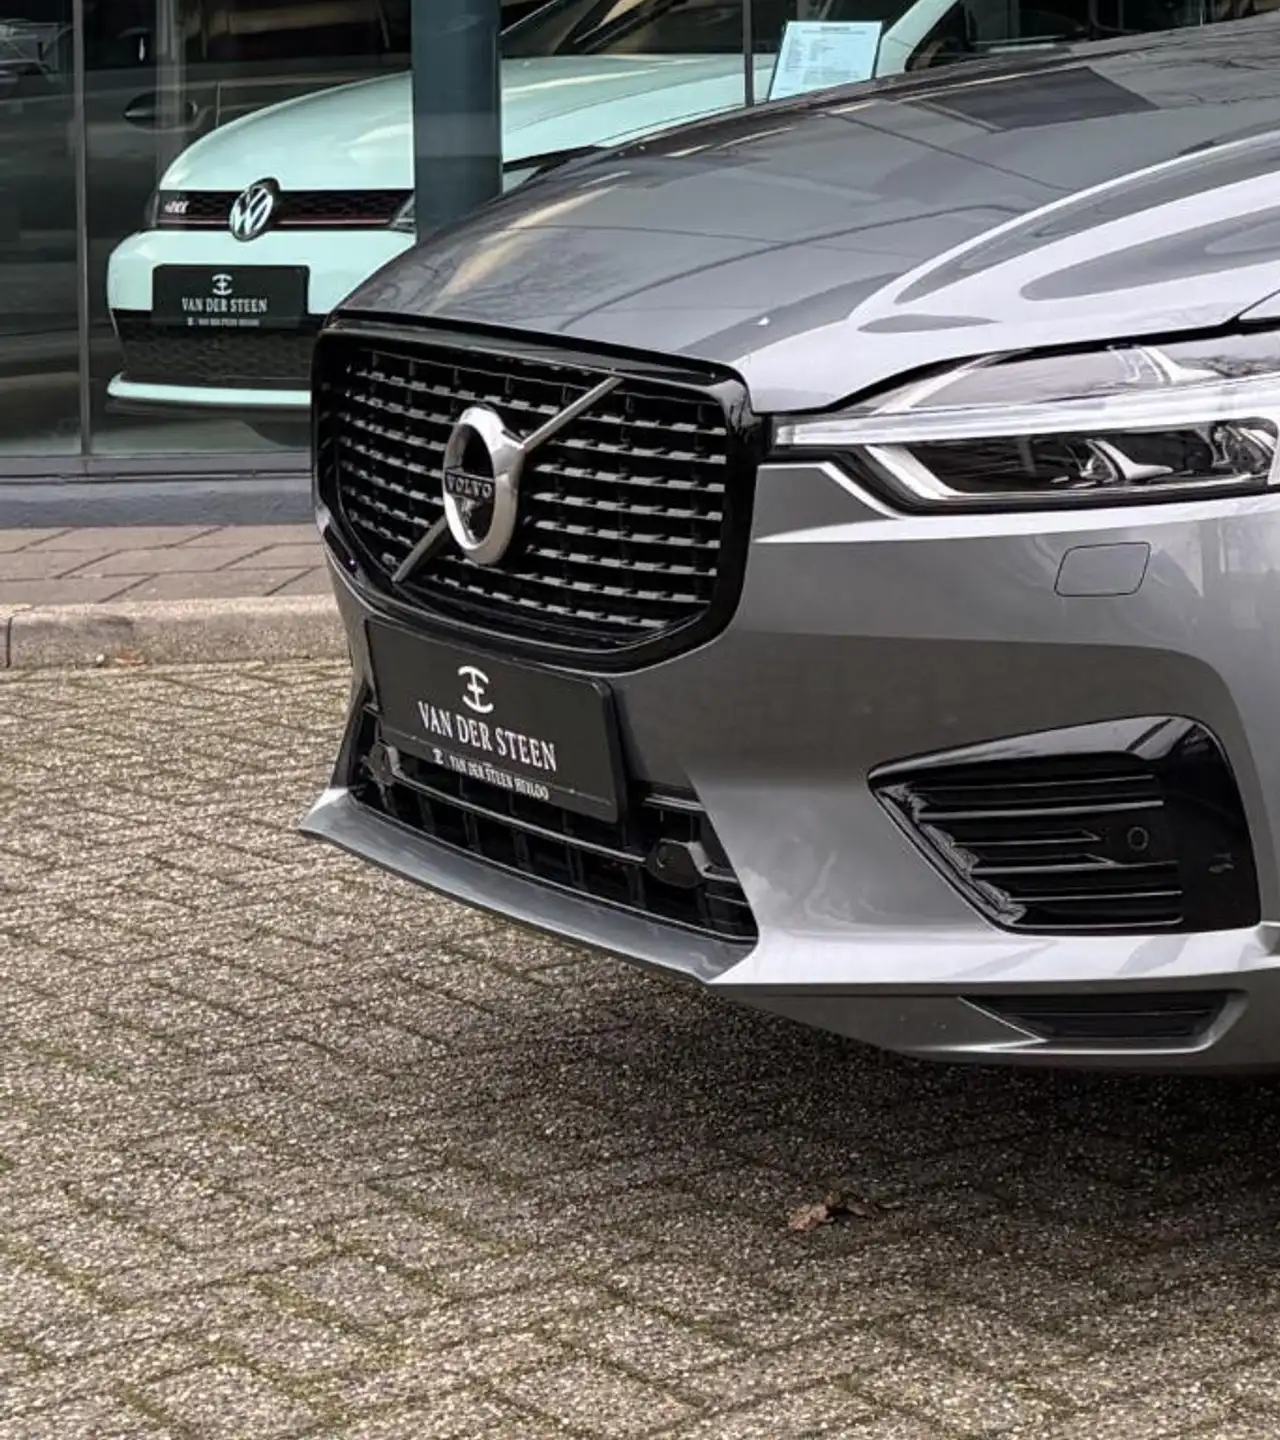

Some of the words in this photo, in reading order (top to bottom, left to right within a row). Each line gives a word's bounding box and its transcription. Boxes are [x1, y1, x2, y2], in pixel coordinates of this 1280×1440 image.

[182, 297, 203, 311] VAN
[206, 297, 228, 313] DER
[230, 298, 268, 313] STEEN
[447, 473, 492, 498] VOLVO
[418, 700, 453, 738] VAN
[456, 714, 493, 751] DER
[495, 727, 557, 772] STEEN
